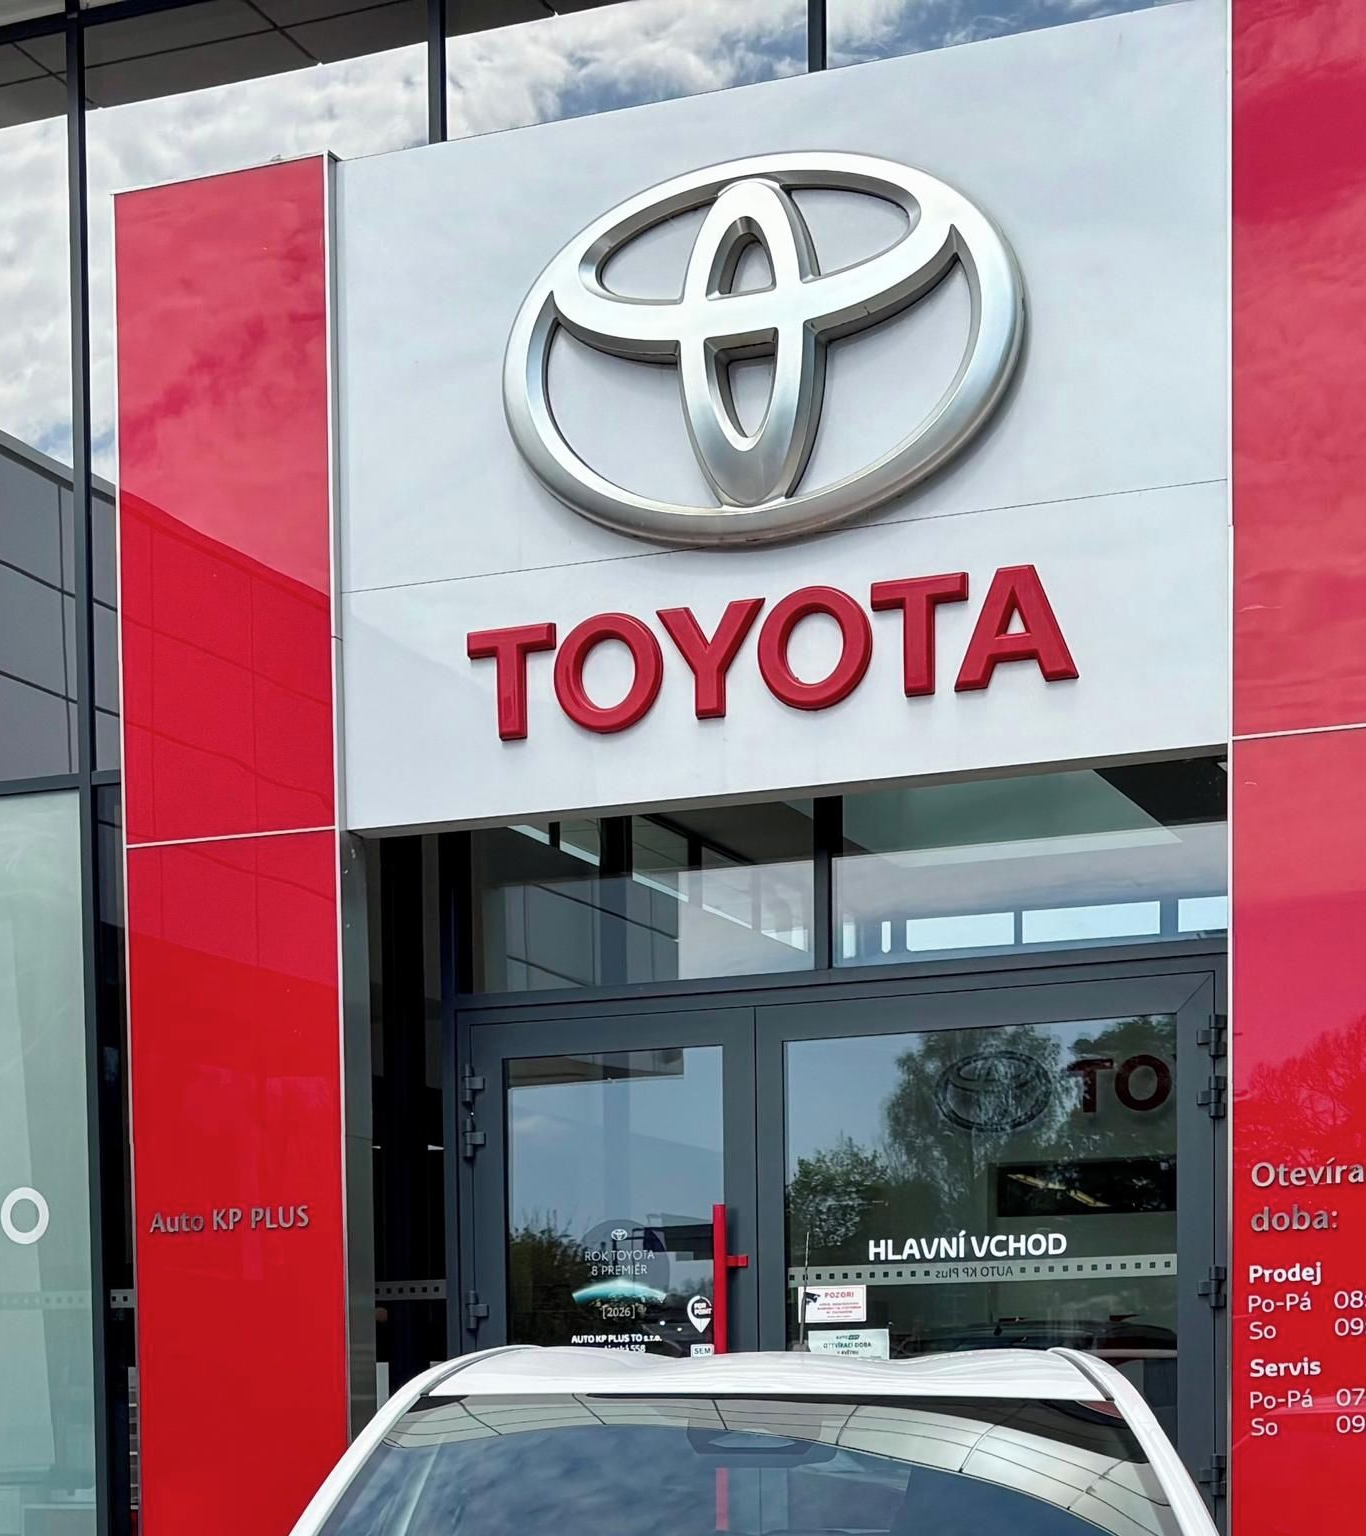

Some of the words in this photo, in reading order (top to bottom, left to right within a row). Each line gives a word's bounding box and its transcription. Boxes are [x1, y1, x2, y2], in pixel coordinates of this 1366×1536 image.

[467, 563, 1080, 741] TOYOTA
[149, 1211, 204, 1234] Auto
[212, 1208, 243, 1231] KP
[250, 1205, 310, 1229] PLUS
[1250, 1204, 1338, 1232] doba:
[585, 1251, 608, 1262] ROK
[611, 1250, 655, 1261] TOYOTA
[868, 1230, 966, 1261] HLAVNÍ
[970, 1233, 1067, 1258] VCHOD
[591, 1265, 598, 1276] 8
[601, 1263, 648, 1275] PREMIÉR
[1248, 1262, 1322, 1285] Prodej
[1248, 1291, 1312, 1313] Po-Pá
[571, 1335, 595, 1344] AUTO
[595, 1335, 608, 1343] KP
[608, 1334, 630, 1342] PLUS
[1249, 1321, 1276, 1340] So
[693, 1347, 711, 1355] SEM
[1249, 1357, 1322, 1378] Servis
[1249, 1388, 1314, 1409] Po-Pá
[1250, 1417, 1278, 1436] So
